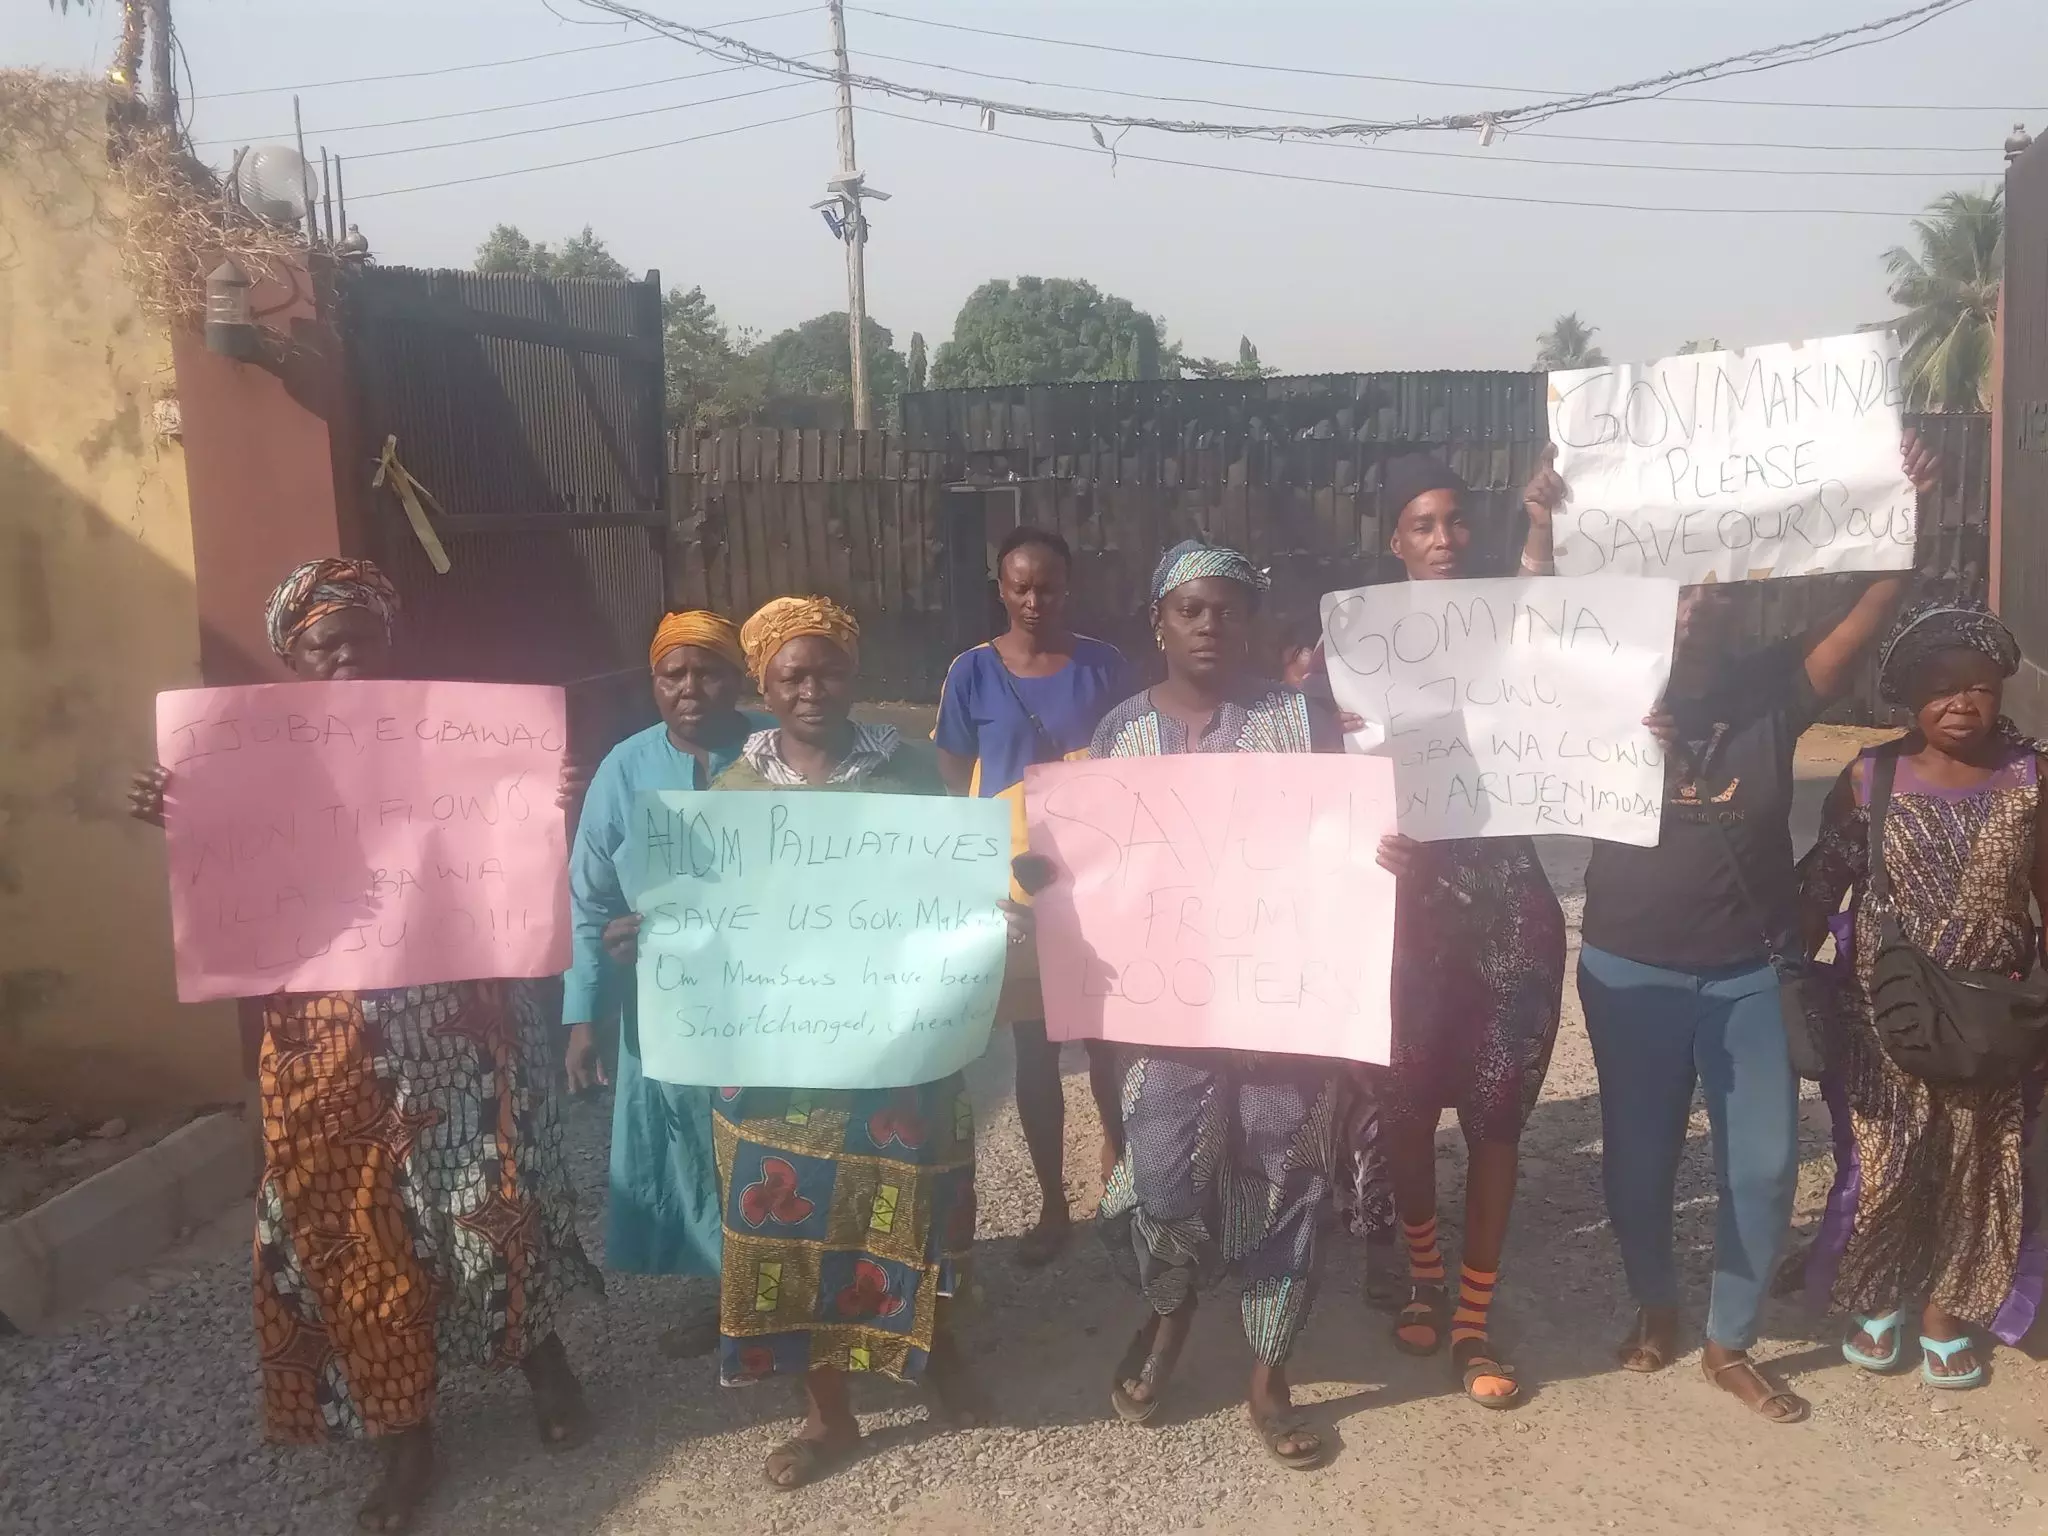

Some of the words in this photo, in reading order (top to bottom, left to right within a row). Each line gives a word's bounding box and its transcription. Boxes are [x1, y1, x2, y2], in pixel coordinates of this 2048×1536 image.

[1665, 440, 1819, 502] PLEASE
[1577, 507, 1712, 577] SAVE
[1716, 503, 1809, 549] OUR
[1327, 595, 1620, 677] GOMINA,
[376, 716, 404, 742] E
[1491, 730, 1543, 763] WA
[768, 804, 999, 869] PALLIATIVES
[651, 900, 760, 938] SAVE
[787, 903, 834, 932] US
[861, 957, 926, 986] have
